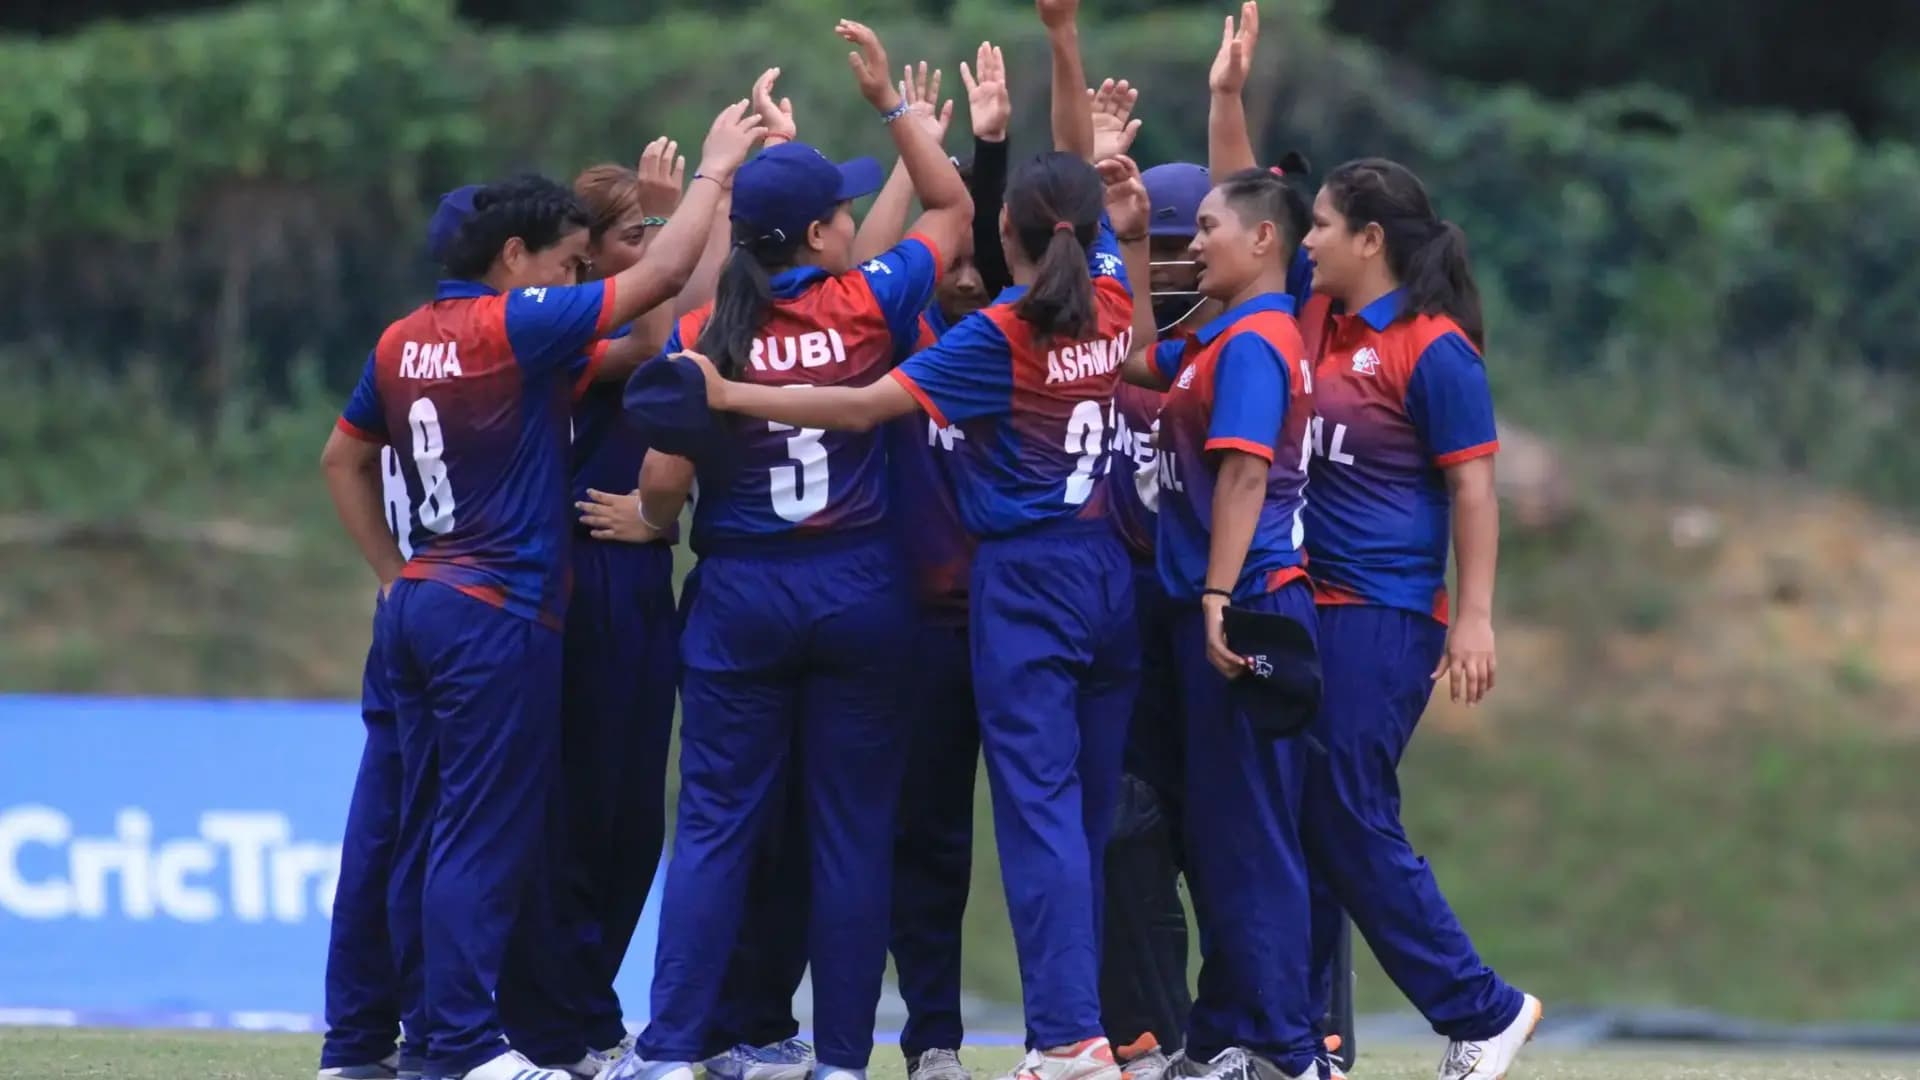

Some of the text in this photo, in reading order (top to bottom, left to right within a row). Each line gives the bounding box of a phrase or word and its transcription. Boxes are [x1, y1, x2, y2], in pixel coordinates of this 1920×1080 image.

[399, 341, 463, 379] RANA
[749, 328, 846, 371] RUBI
[409, 398, 456, 534] 8
